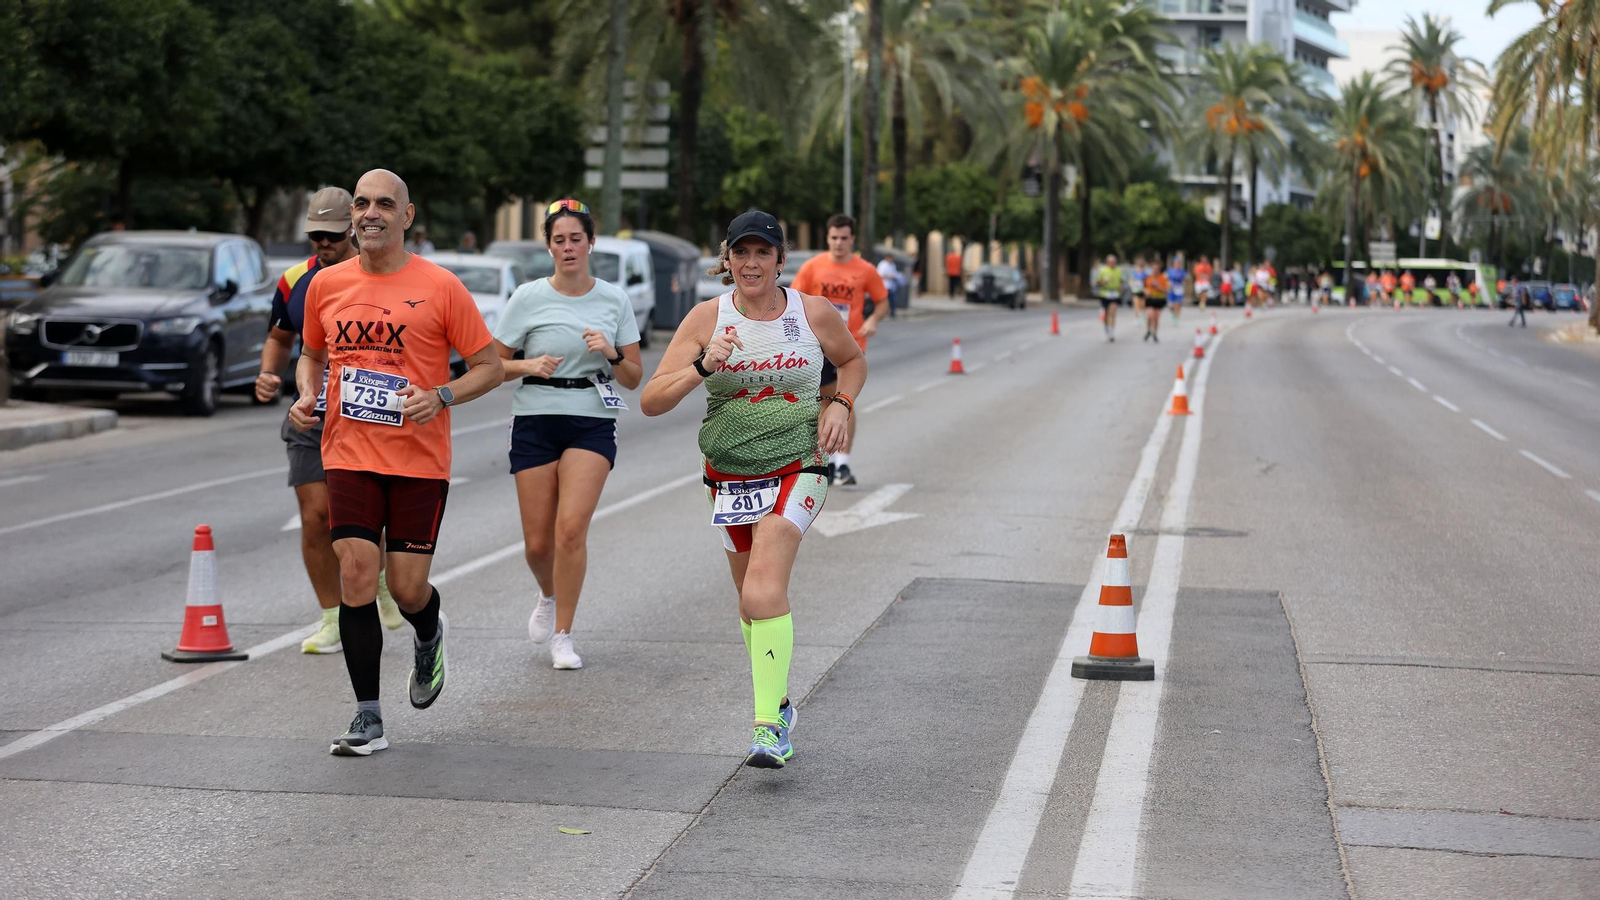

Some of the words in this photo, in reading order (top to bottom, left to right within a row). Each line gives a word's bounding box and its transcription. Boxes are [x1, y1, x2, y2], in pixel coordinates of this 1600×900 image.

[335, 320, 407, 348] XXIX
[716, 351, 810, 373] maratón
[741, 375, 785, 384] JEREZ
[354, 385, 389, 407] 735
[731, 491, 763, 511] 601
